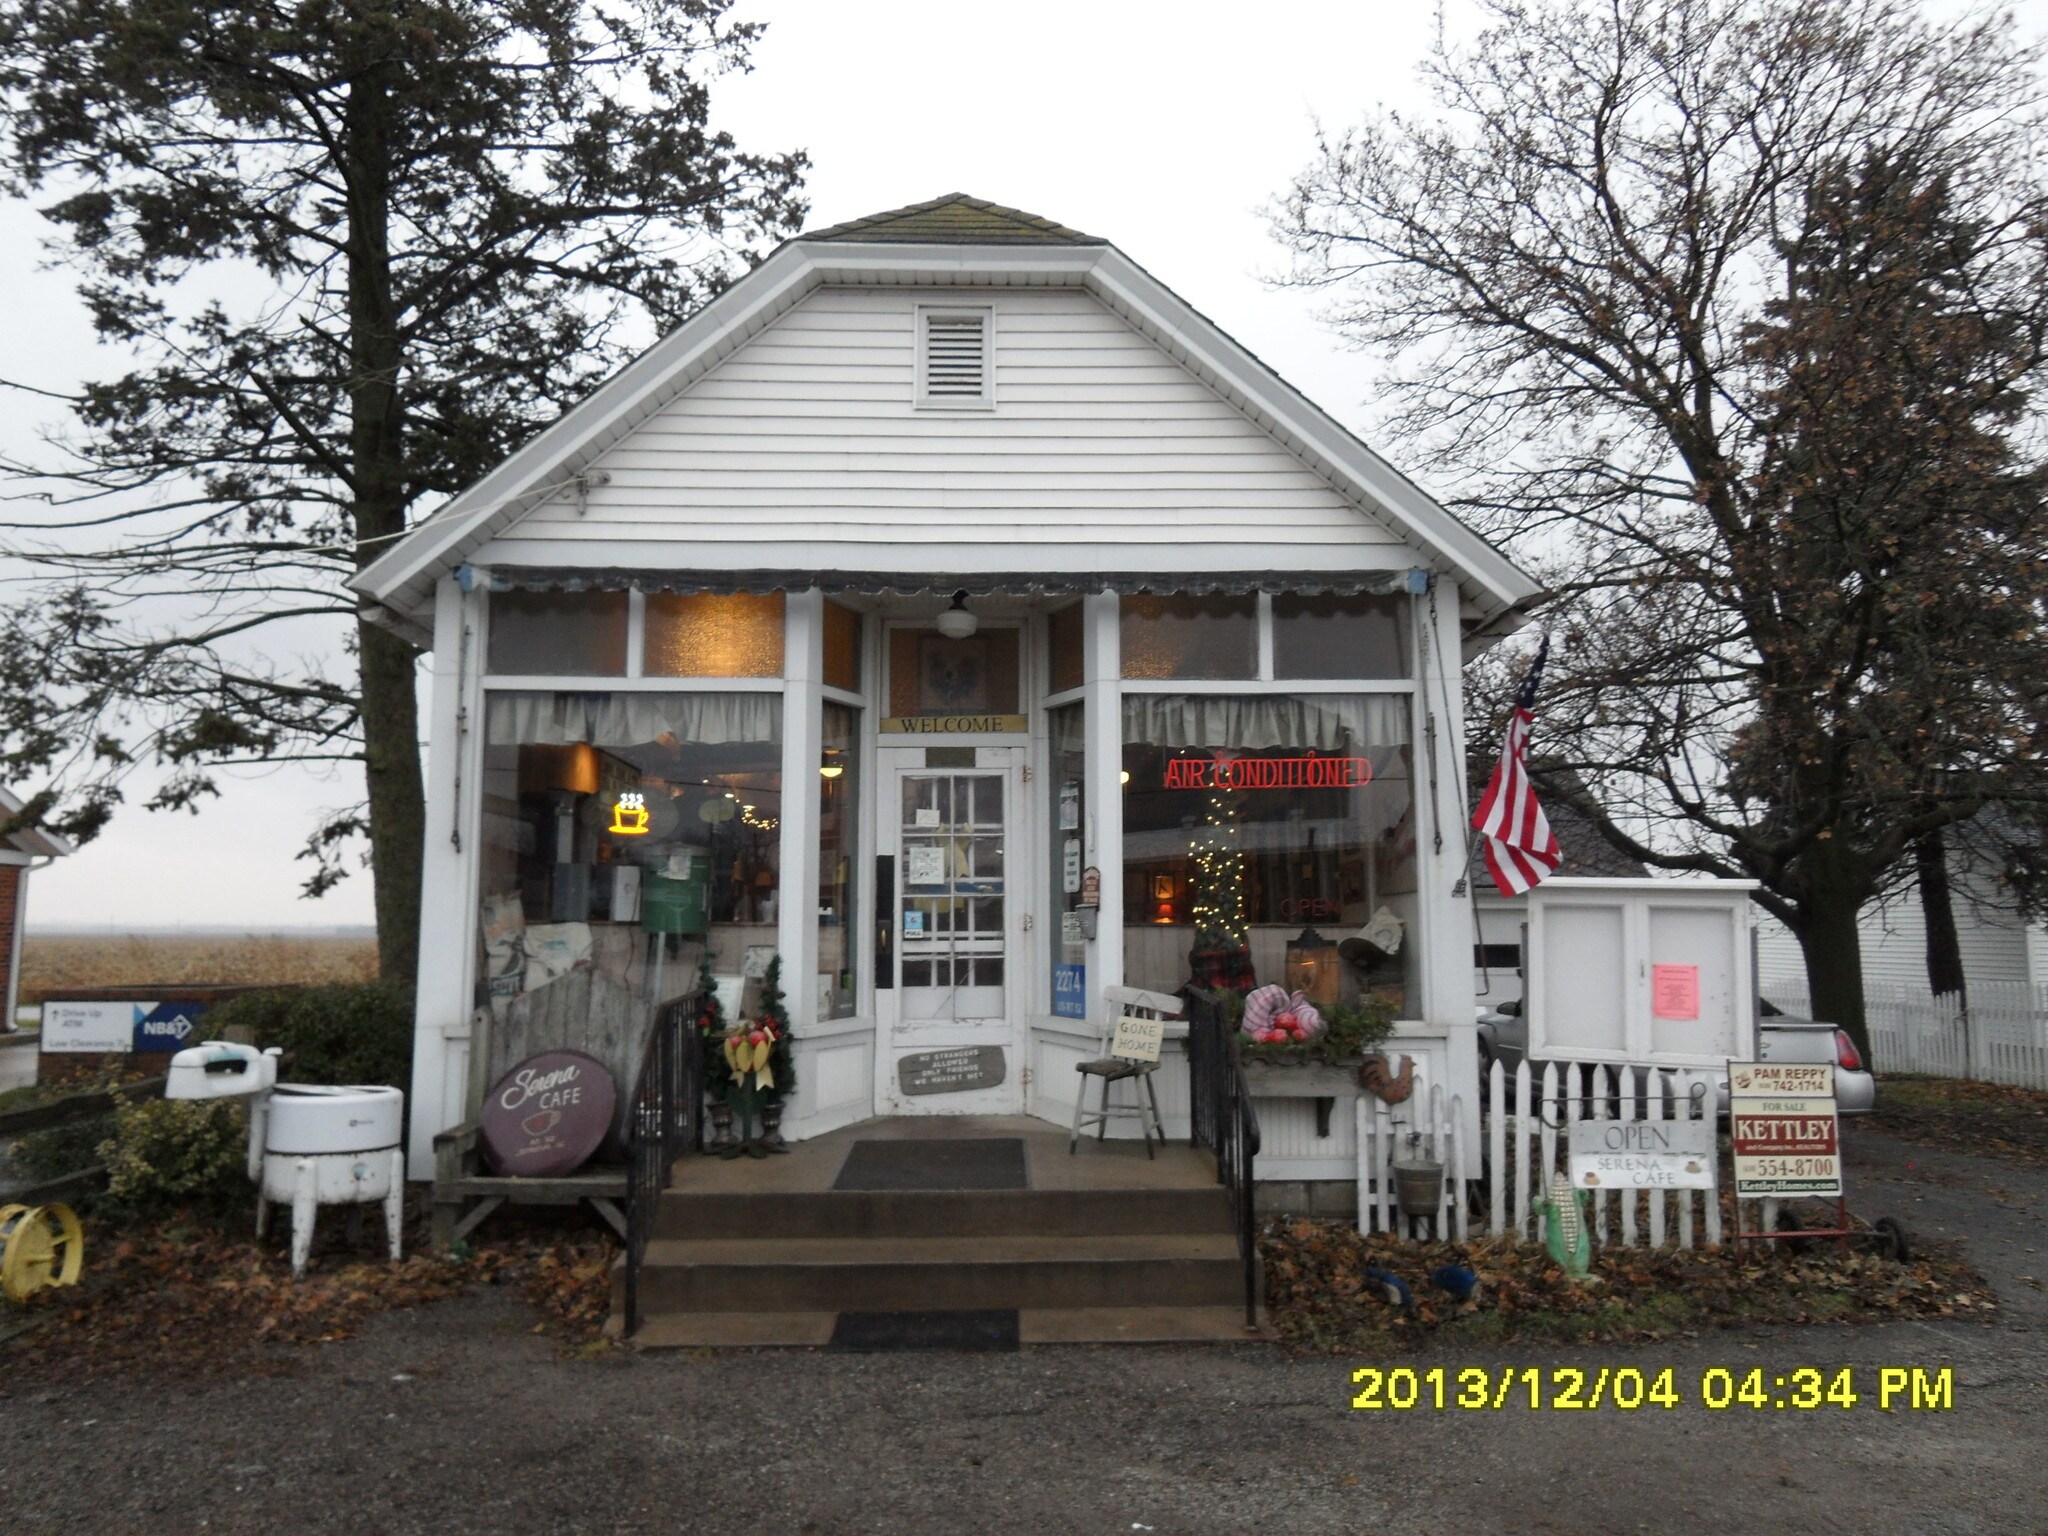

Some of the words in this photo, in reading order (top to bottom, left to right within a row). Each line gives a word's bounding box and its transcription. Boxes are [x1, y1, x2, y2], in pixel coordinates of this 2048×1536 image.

[901, 718, 1003, 733] WELCOME
[1165, 758, 1205, 788] AIR
[1214, 757, 1372, 788] CONDITIONED
[1280, 899, 1342, 917] OPEN
[1056, 970, 1081, 992] 2274
[62, 1009, 86, 1017] Drive
[88, 1009, 102, 1018] Up
[62, 1019, 83, 1027] ATM
[144, 1021, 185, 1035] NB&T
[1120, 1022, 1157, 1037] GONE
[1117, 1039, 1157, 1053] HOME
[934, 1049, 979, 1060] STRANGERS
[932, 1058, 968, 1068] ALLOWED
[1754, 1068, 1781, 1079] PAM
[1785, 1068, 1826, 1079] REPPY
[501, 1065, 580, 1109] Serena
[1773, 1080, 1824, 1091] 742-1714
[540, 1087, 581, 1109] CAFE
[1763, 1103, 1781, 1111] FOR
[1785, 1103, 1807, 1111] SALE
[1737, 1120, 1832, 1140] KETTLEY
[1605, 1126, 1670, 1150] OPEN
[1598, 1158, 1661, 1170] SERENA
[1758, 1158, 1833, 1176] 554-8700
[1633, 1171, 1676, 1184] CAFE
[1741, 1181, 1837, 1192] KettleyHomes.com
